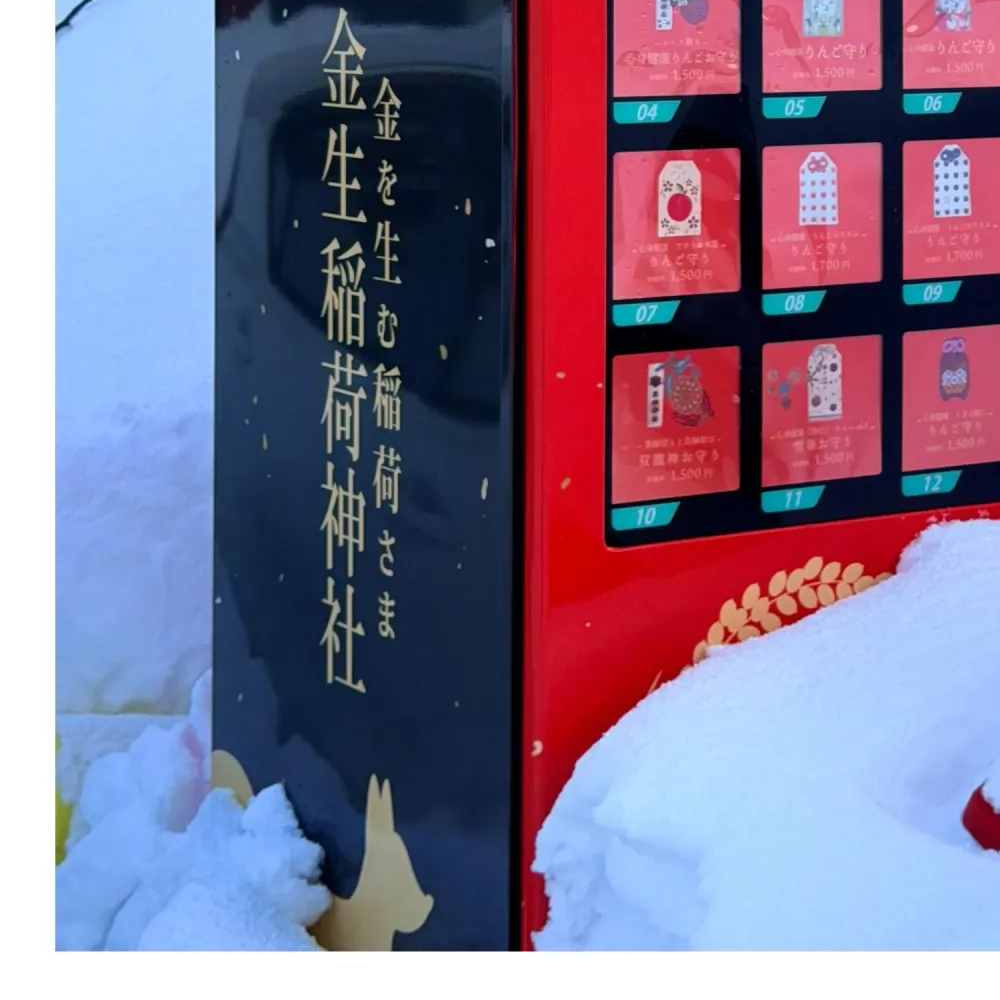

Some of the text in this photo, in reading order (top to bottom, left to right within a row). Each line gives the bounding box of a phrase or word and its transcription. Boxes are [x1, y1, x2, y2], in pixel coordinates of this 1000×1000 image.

[636, 103, 659, 121] 04
[784, 99, 805, 117] 05
[923, 95, 943, 112] 06
[923, 284, 943, 302] 09
[784, 294, 805, 312] 08
[635, 304, 658, 323] 07
[320, 7, 367, 694] 金生稲荷神社
[372, 76, 402, 639] 金を生む稲荷さま
[924, 474, 943, 493] 12
[785, 490, 803, 509] 11
[636, 506, 657, 527] 10
